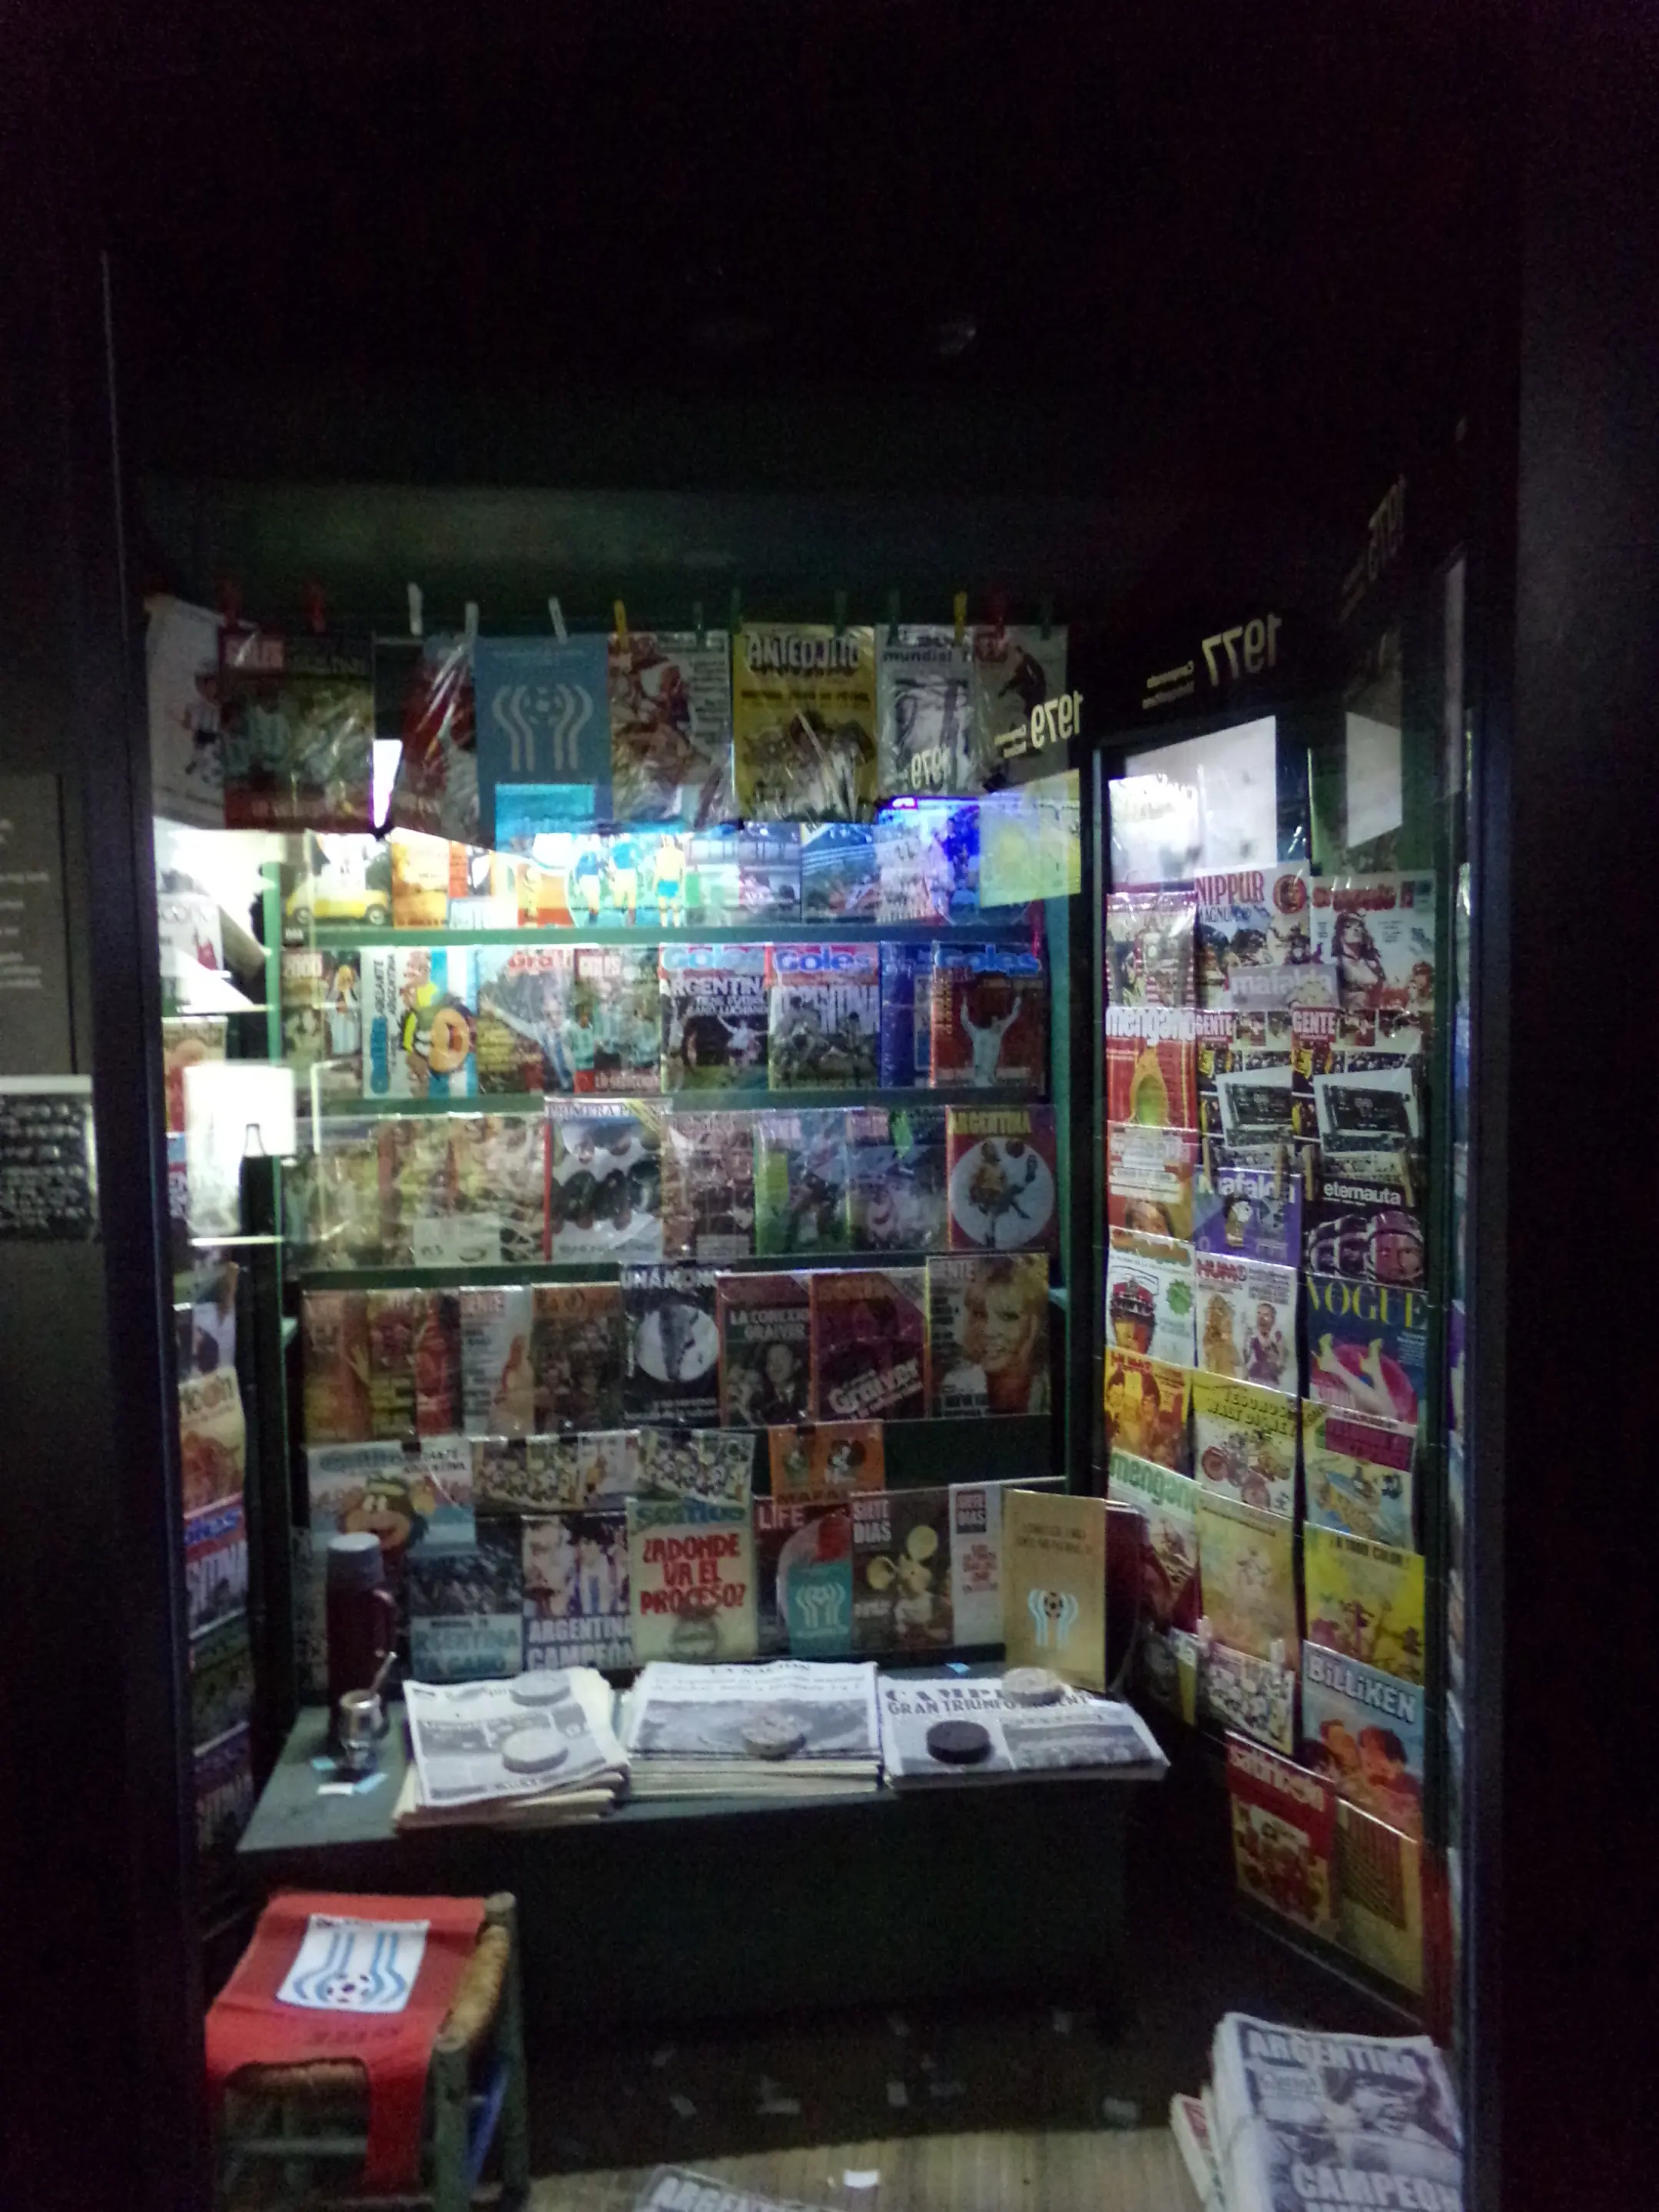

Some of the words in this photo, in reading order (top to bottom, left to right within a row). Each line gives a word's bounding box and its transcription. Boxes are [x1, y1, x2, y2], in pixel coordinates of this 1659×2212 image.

[1196, 870, 1265, 905] NIPPUR
[774, 945, 874, 975] Goles
[934, 944, 1044, 976] Goles
[1196, 1012, 1233, 1036] GENTE
[1292, 1008, 1336, 1035] GENTE
[1323, 1181, 1402, 1206] eternauta
[1306, 1275, 1429, 1331] VOGUE
[758, 1503, 805, 1530] LIFE
[853, 1498, 890, 1521] SIETE
[663, 1560, 692, 1586] VA
[698, 1558, 721, 1584] EL
[640, 1583, 747, 1615] PROCESO?
[887, 1698, 940, 1715] GRAN
